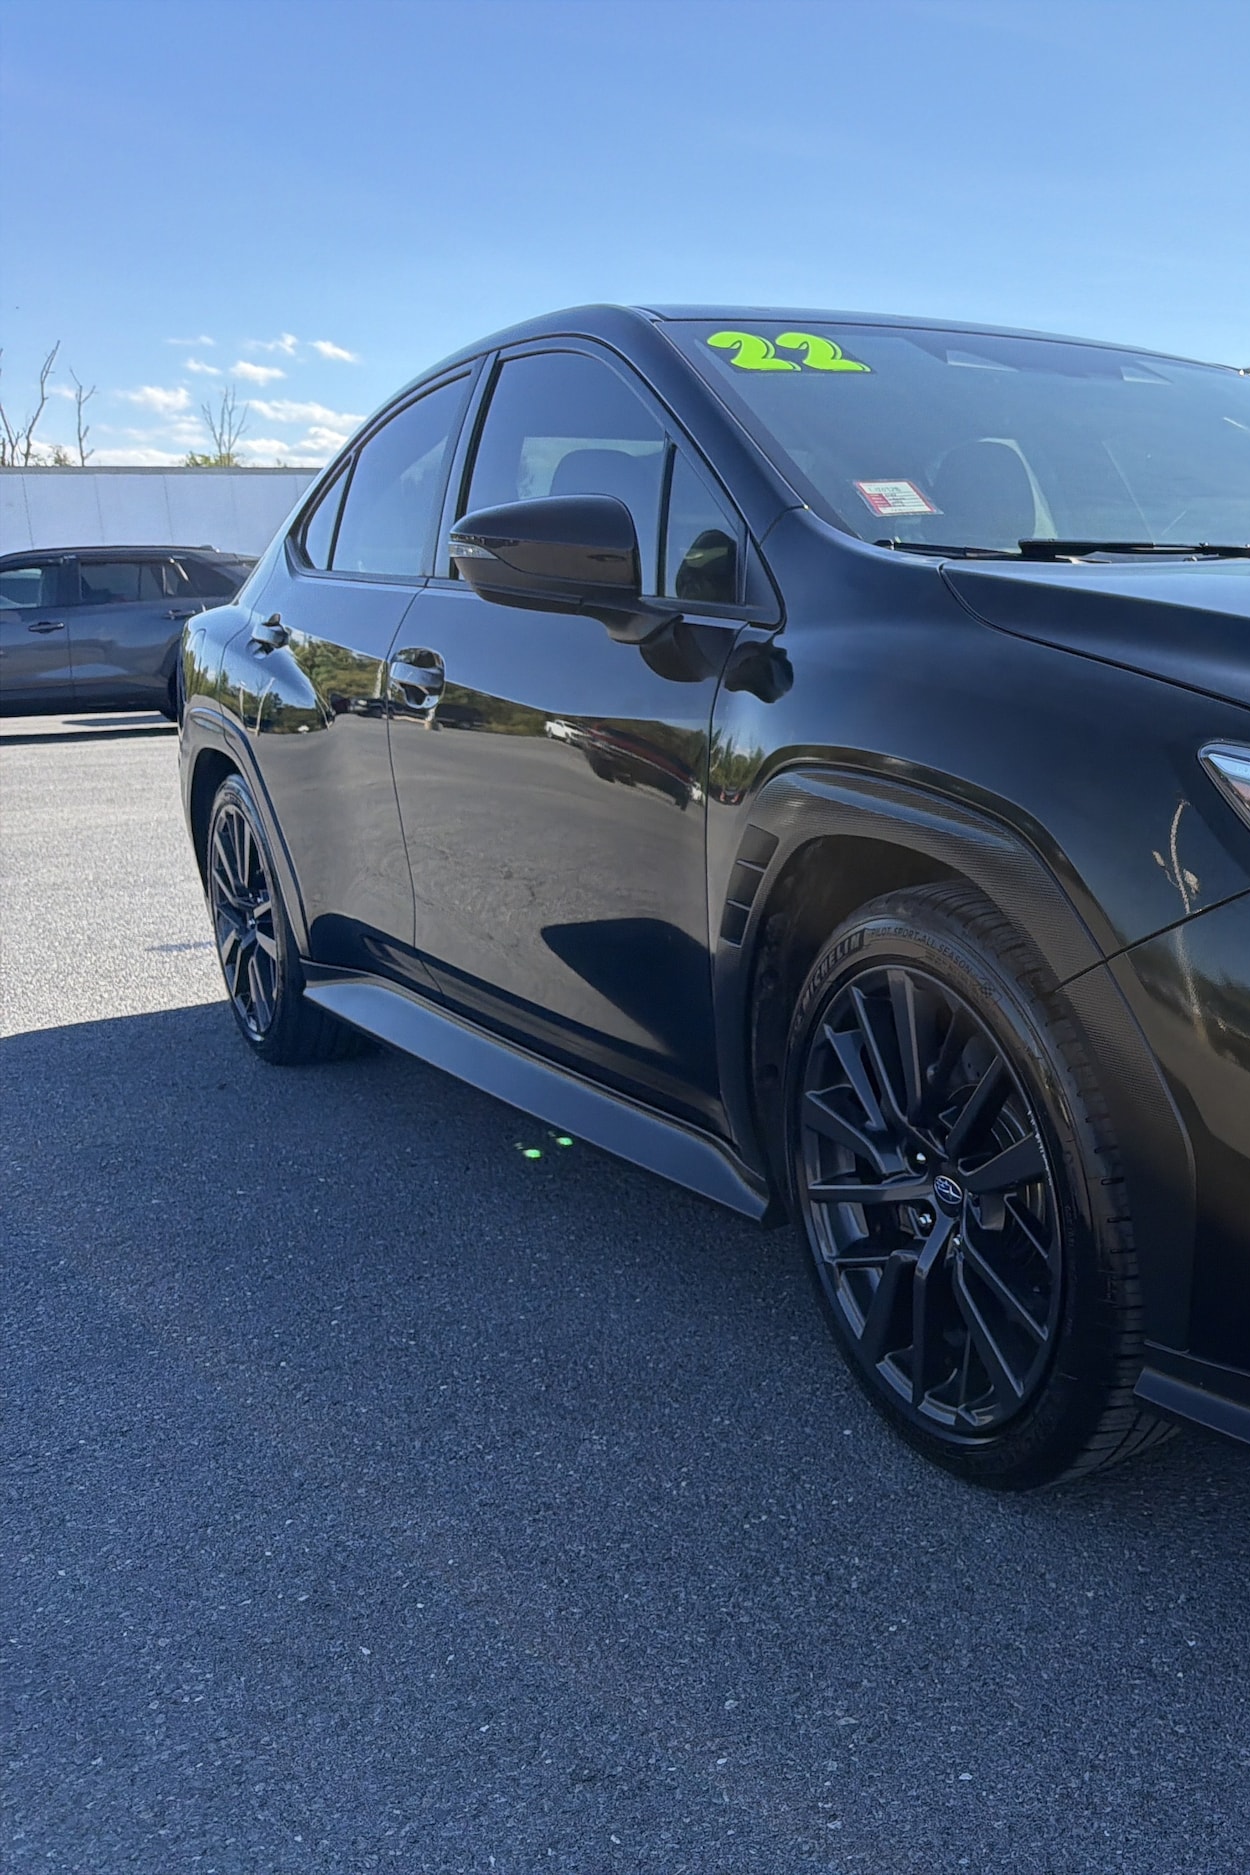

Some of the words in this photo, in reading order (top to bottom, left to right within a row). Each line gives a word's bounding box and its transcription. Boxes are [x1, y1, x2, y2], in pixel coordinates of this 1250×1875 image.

[706, 331, 872, 372] 22
[871, 927, 892, 938] PILOT
[894, 927, 920, 941] SPORT
[921, 935, 936, 949] ALL
[937, 944, 973, 974] SEASON
